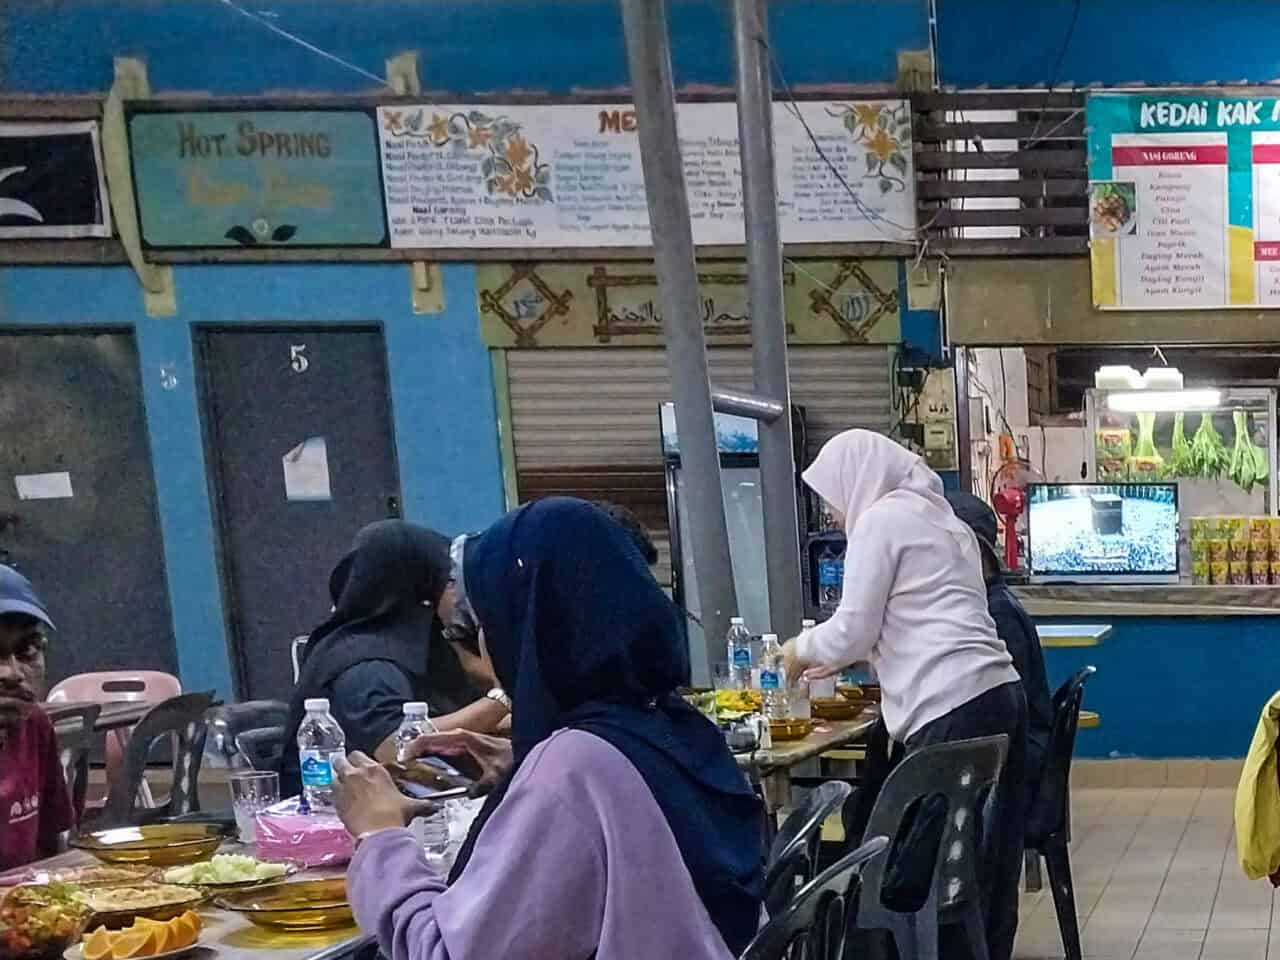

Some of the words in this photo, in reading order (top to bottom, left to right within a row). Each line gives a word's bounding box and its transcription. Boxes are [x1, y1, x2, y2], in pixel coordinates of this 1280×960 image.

[599, 110, 639, 134] ME
[1216, 101, 1262, 126] KAK
[289, 344, 310, 374] 5
